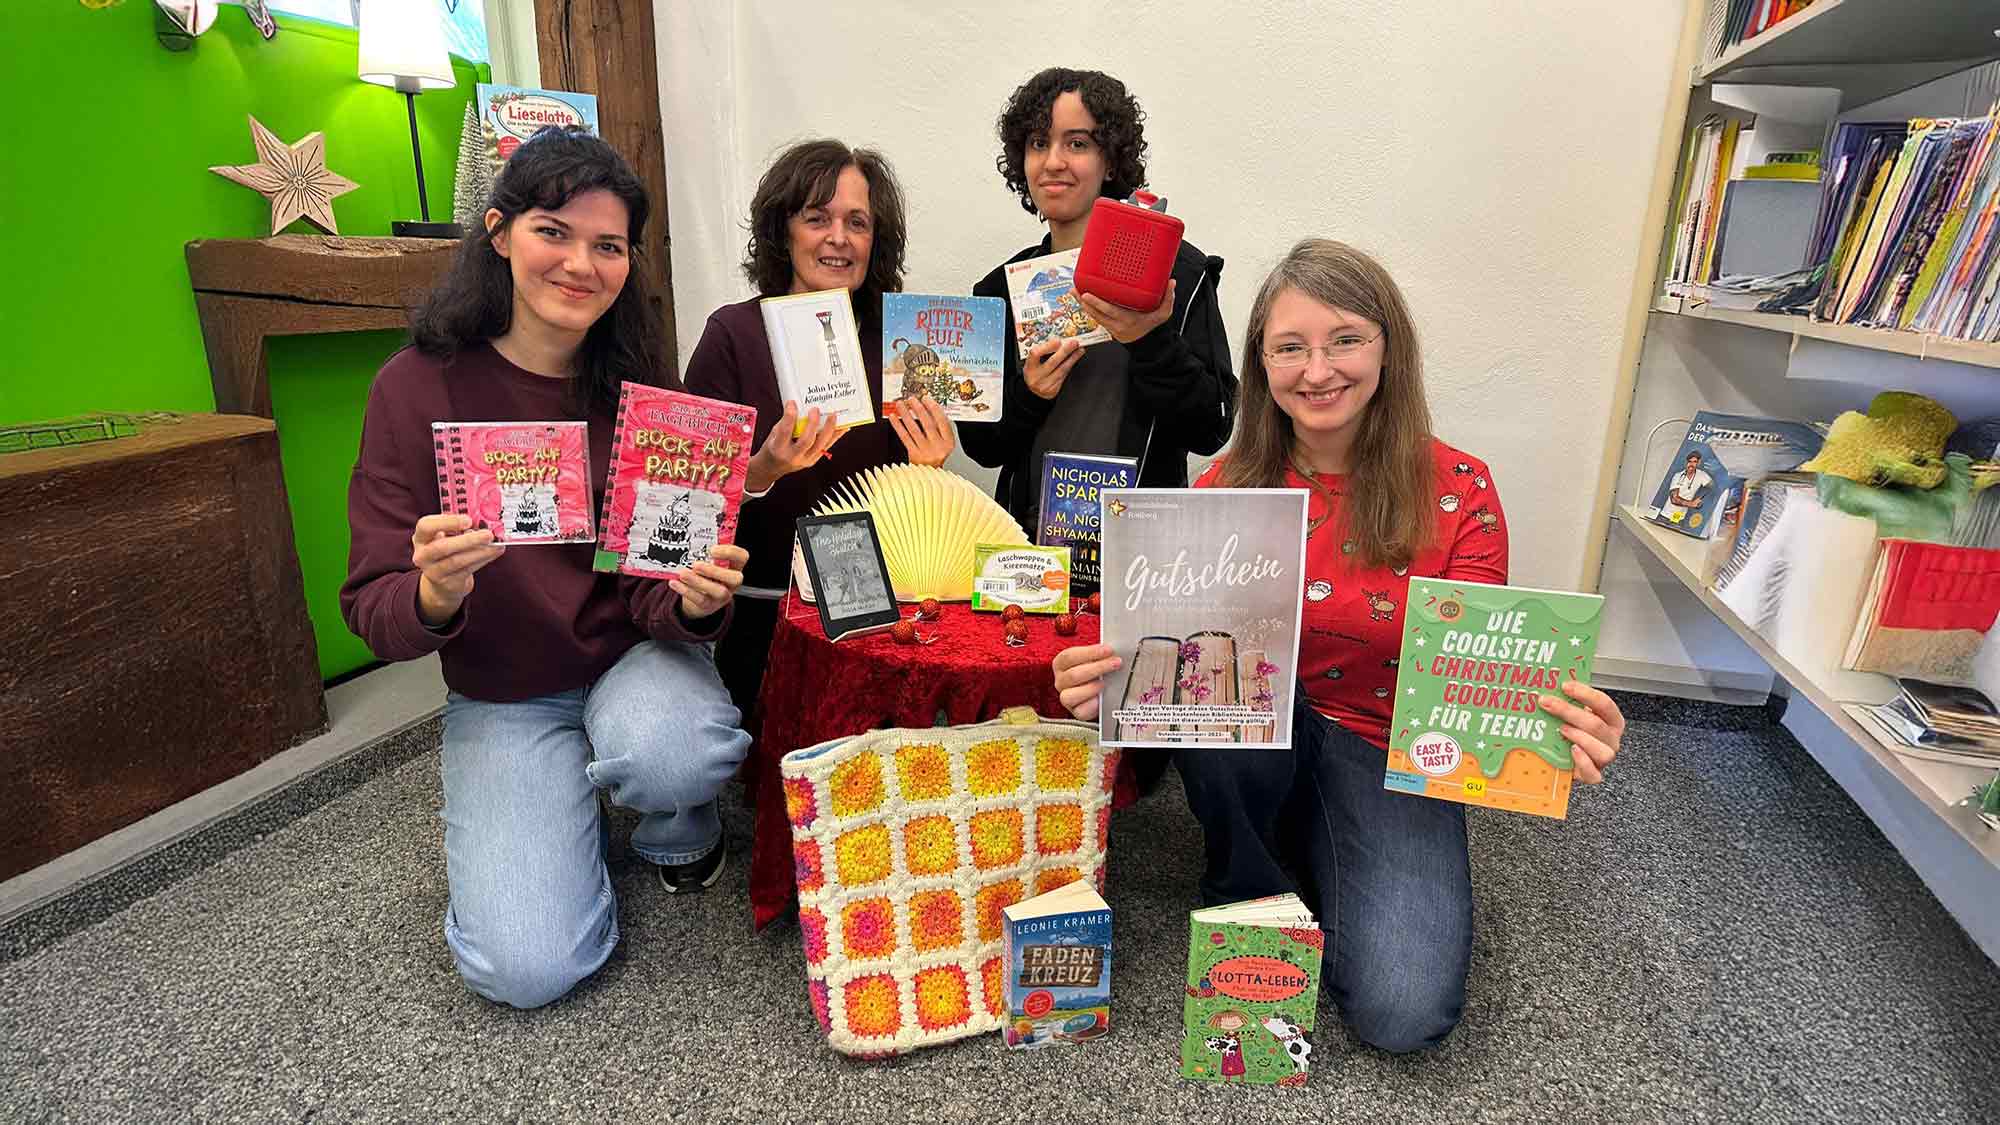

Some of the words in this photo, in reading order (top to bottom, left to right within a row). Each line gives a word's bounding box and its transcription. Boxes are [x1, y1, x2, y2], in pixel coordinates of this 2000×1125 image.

[508, 105, 574, 124] Lieselotte
[915, 308, 974, 332] RITTER
[927, 328, 964, 348] EULE
[949, 355, 998, 367] Weihnachten
[804, 392, 833, 404] Königin
[833, 387, 857, 399] Esther
[807, 383, 826, 394] John
[827, 380, 852, 391] Irving
[634, 428, 692, 457] BOCK
[703, 436, 742, 459] AUF
[483, 450, 527, 466] BOCK
[534, 447, 561, 462] AUF
[496, 465, 559, 483] PARTY?
[645, 454, 732, 485] PARTY?
[1051, 466, 1127, 488] NICHOLAS
[1055, 483, 1101, 503] SPAR
[1055, 511, 1070, 524] M.
[1074, 513, 1101, 528] NIG
[1046, 558, 1052, 566] &
[1125, 534, 1285, 611] Gutschein
[1486, 610, 1527, 634] DIE
[1441, 630, 1557, 664] COOLSTEN
[1430, 654, 1561, 690] CHRISTMAS
[1443, 680, 1539, 713] COOKIES
[1428, 703, 1472, 732] FÜR
[1479, 711, 1547, 741] TEENS
[1416, 742, 1447, 757] EASY
[1445, 742, 1454, 753] &
[1421, 754, 1454, 768] TASTY
[1466, 781, 1482, 792] GU
[1017, 919, 1058, 935] LEONIE
[1063, 914, 1111, 928] KRAMER
[1031, 947, 1097, 966] FADEN
[1030, 965, 1093, 983] KREUZ
[1217, 972, 1306, 988] LOTTA-LEBEN
